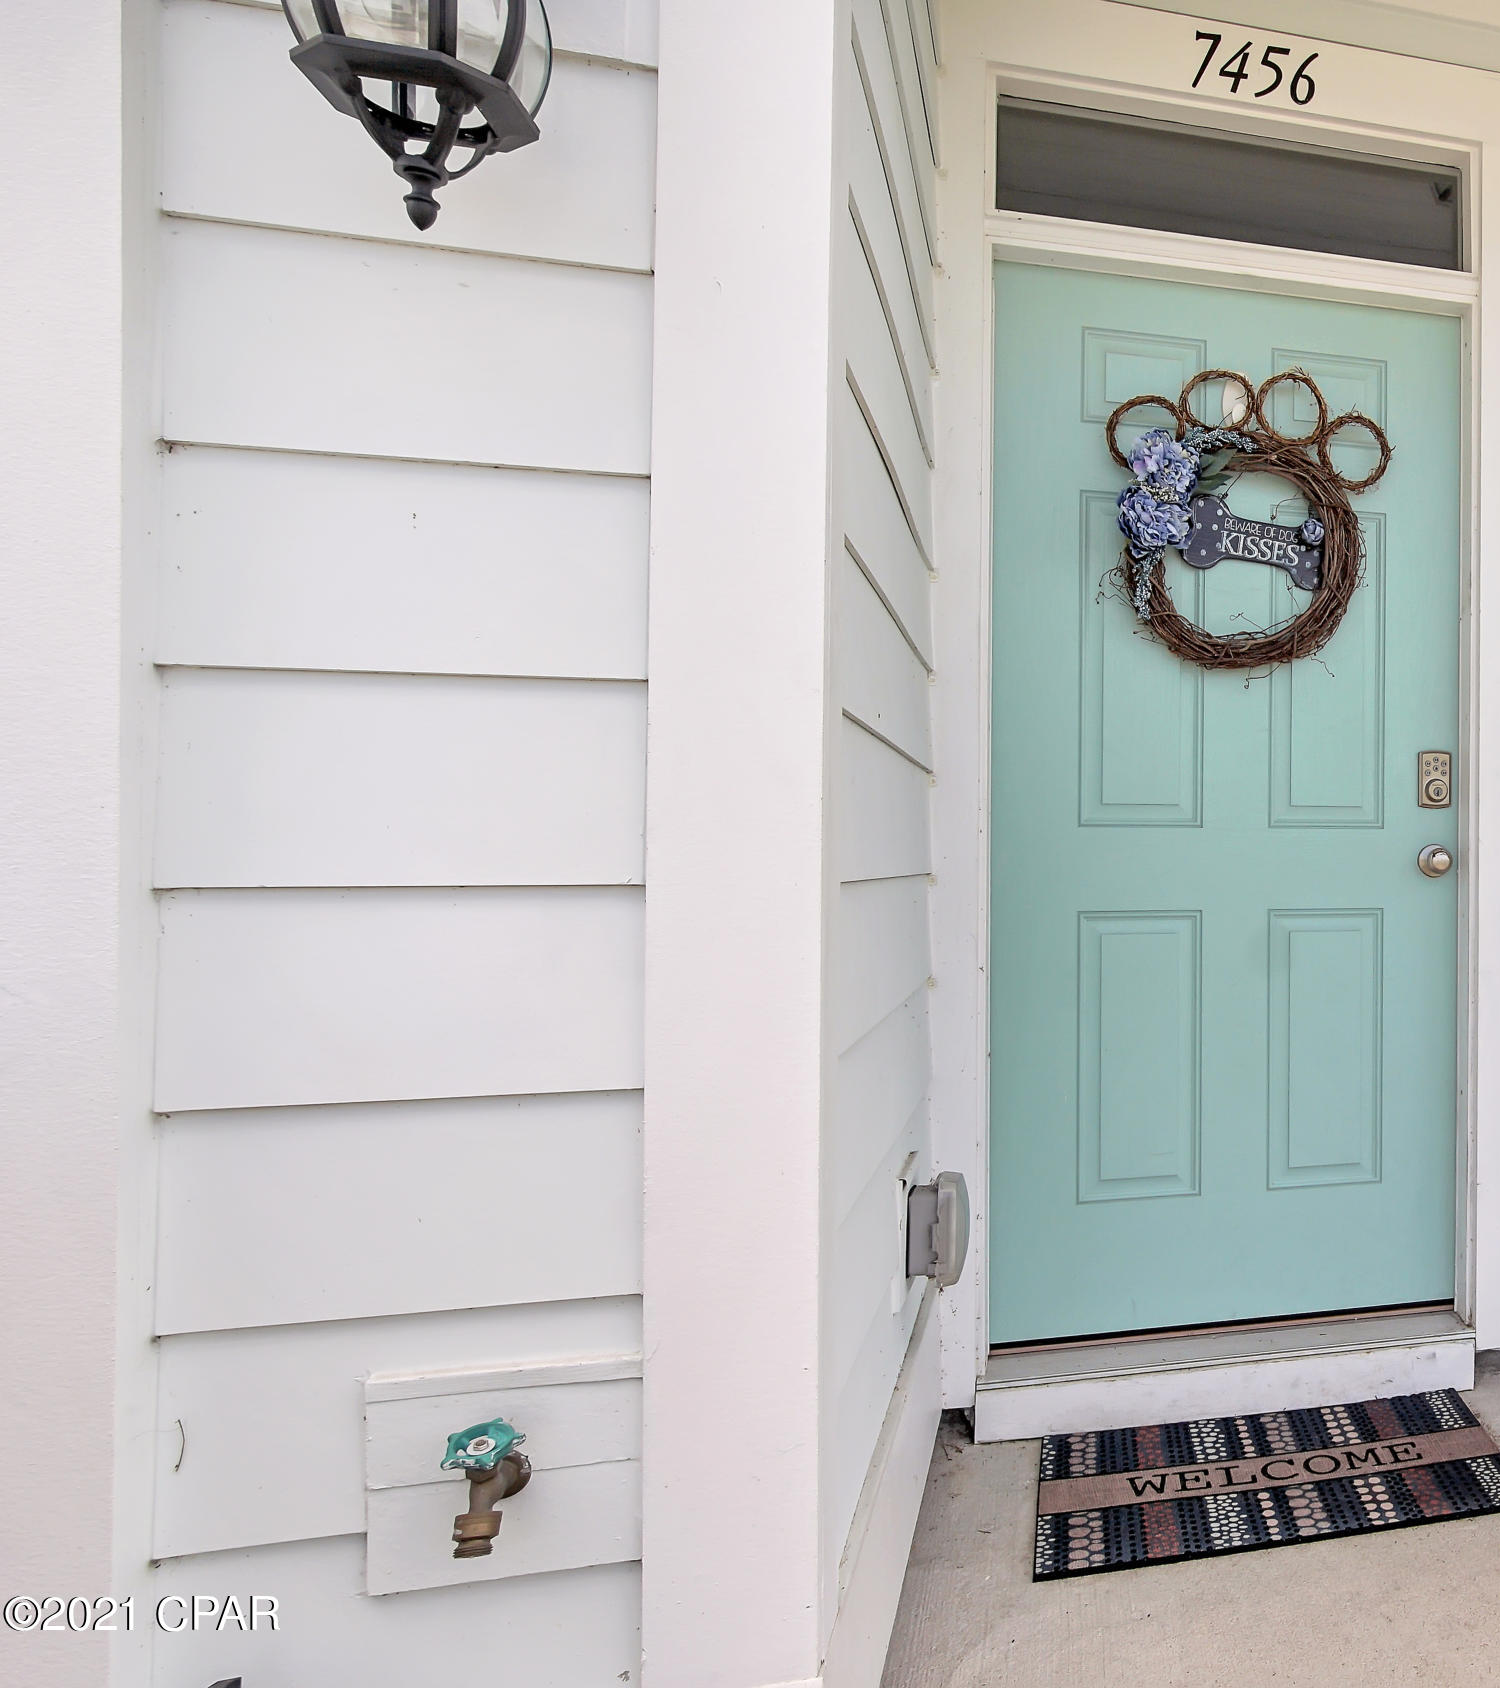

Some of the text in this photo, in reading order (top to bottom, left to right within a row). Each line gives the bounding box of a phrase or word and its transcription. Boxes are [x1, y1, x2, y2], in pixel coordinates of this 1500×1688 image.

[1192, 30, 1319, 105] 7456
[1219, 530, 1300, 566] KISSES
[1224, 518, 1299, 543] BEWARE OF DOG
[1126, 1441, 1424, 1497] WELCOME
